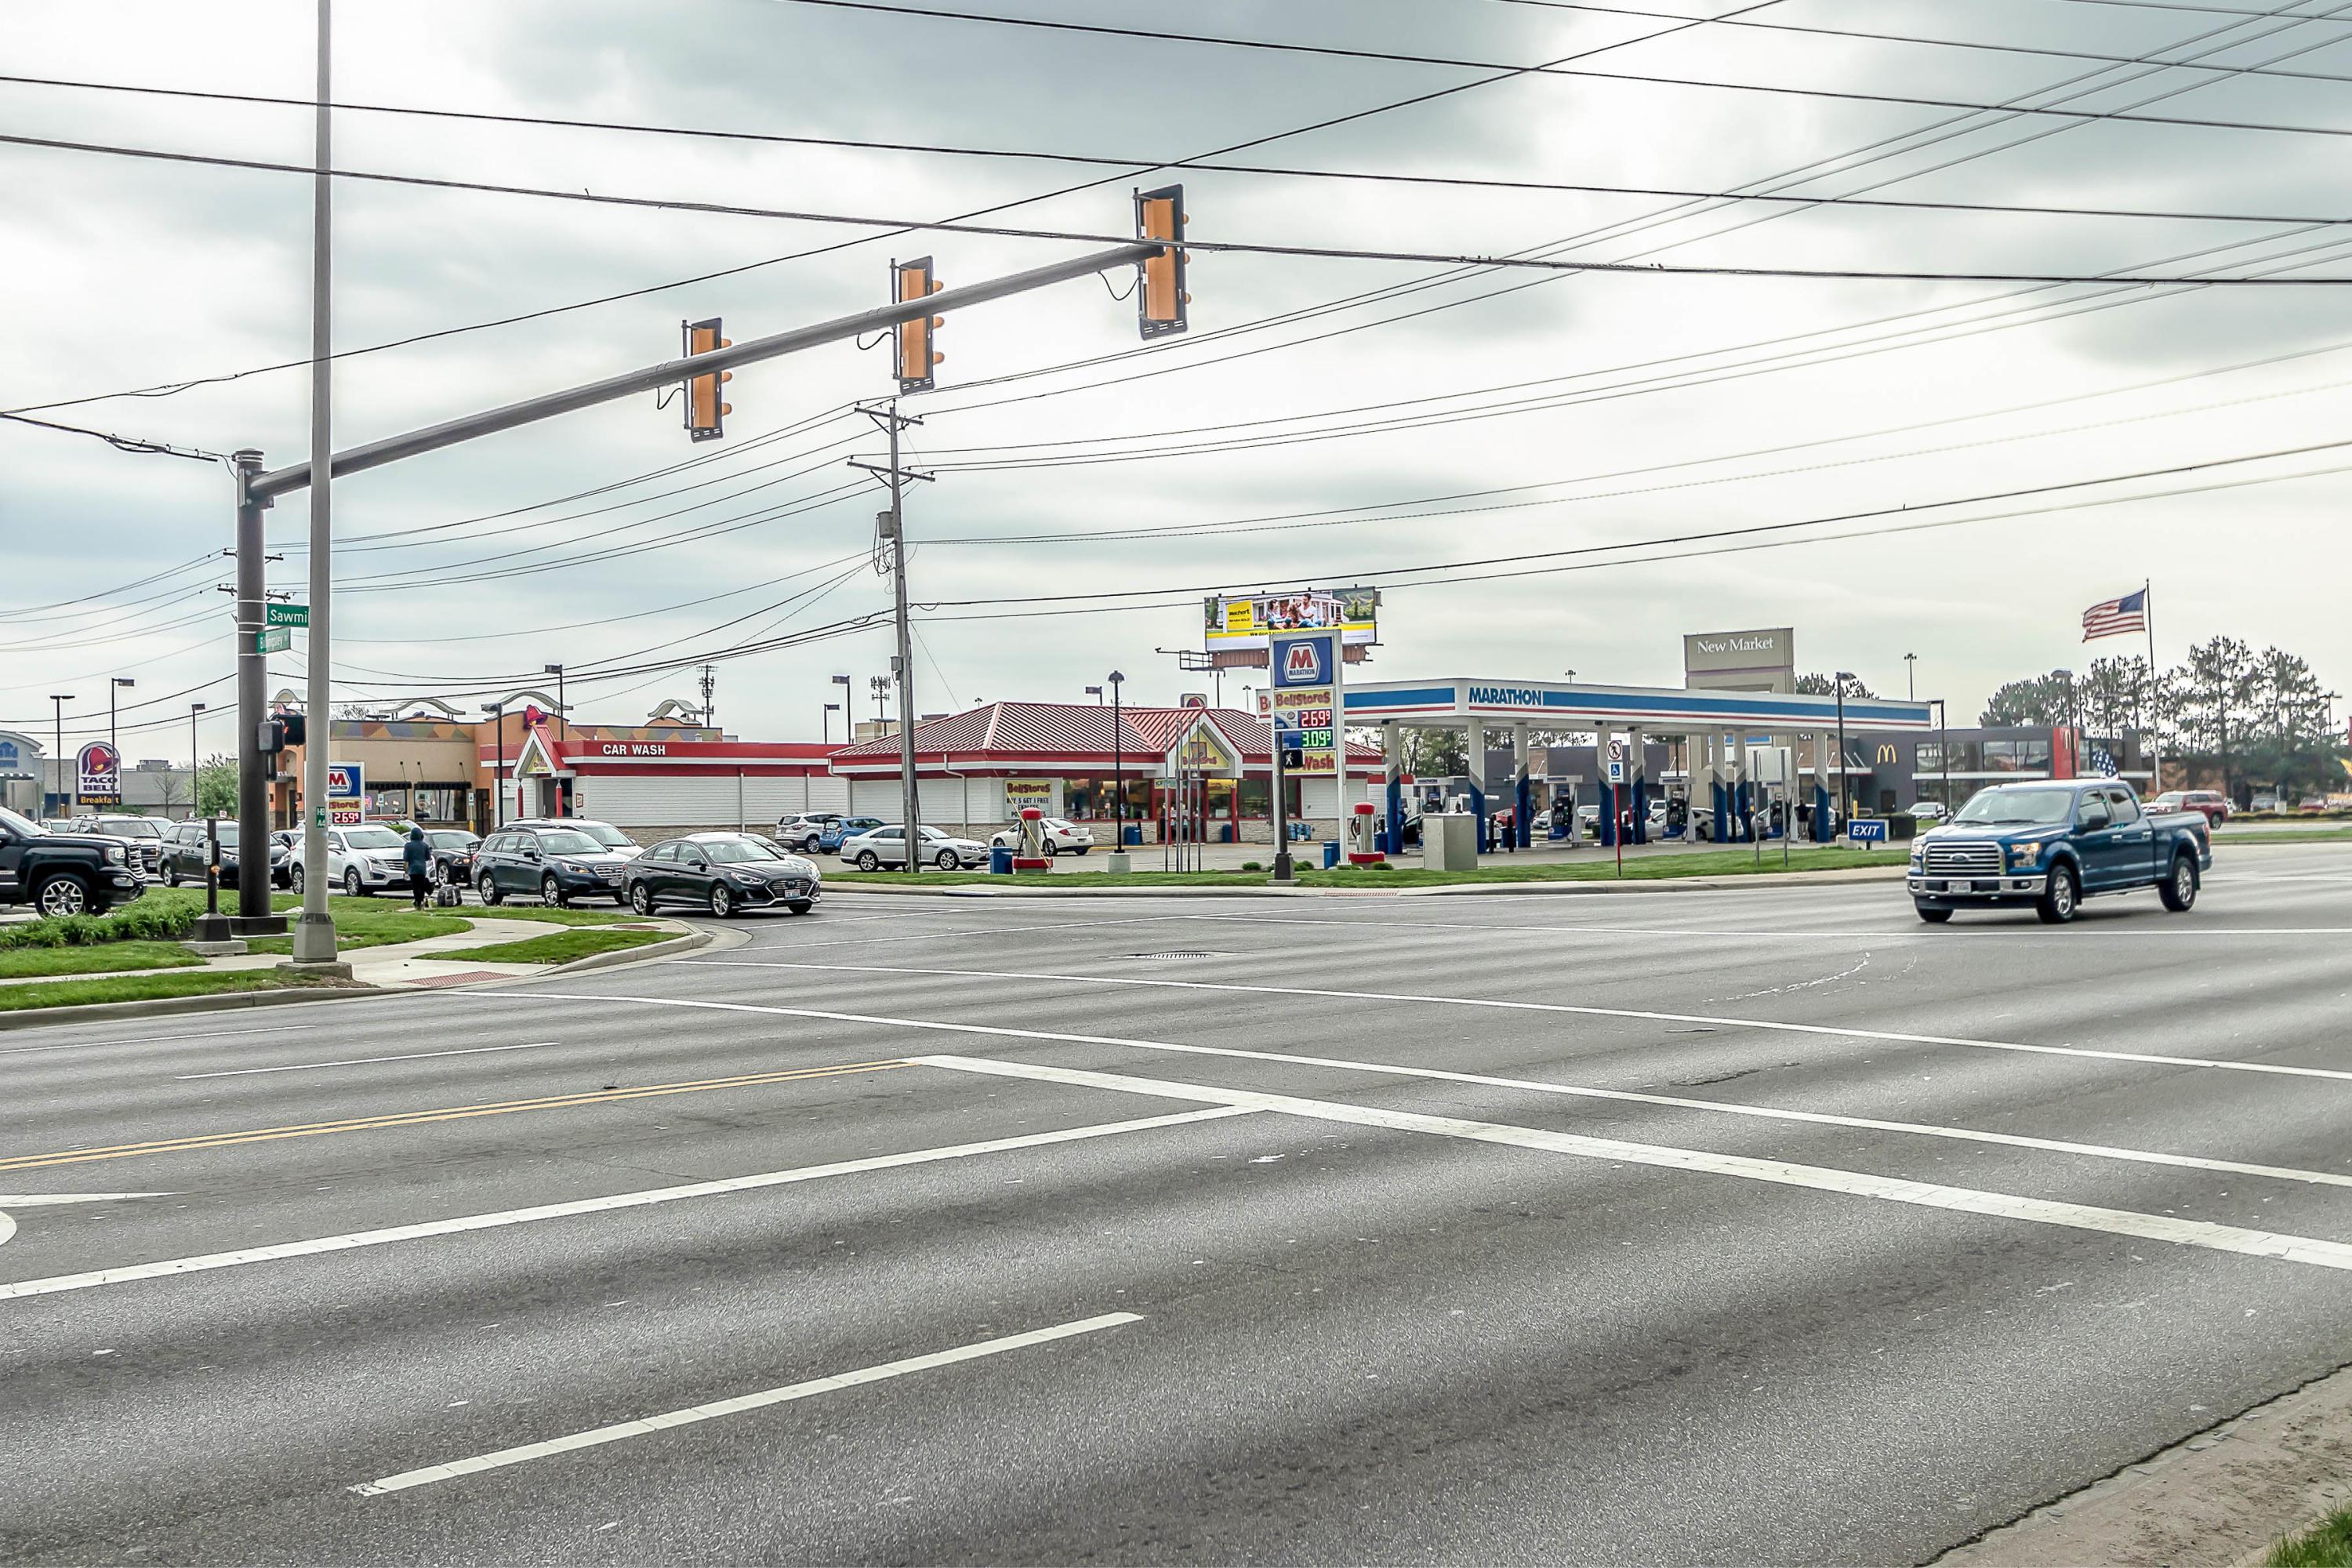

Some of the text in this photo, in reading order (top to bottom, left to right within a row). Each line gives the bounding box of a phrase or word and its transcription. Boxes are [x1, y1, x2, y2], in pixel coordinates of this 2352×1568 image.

[1697, 637, 1774, 653] New Market
[1468, 687, 1542, 706] MARATHON
[603, 745, 666, 755] CAR WASH
[81, 795, 119, 804] Breakfat
[1852, 825, 1880, 837] EXIT
